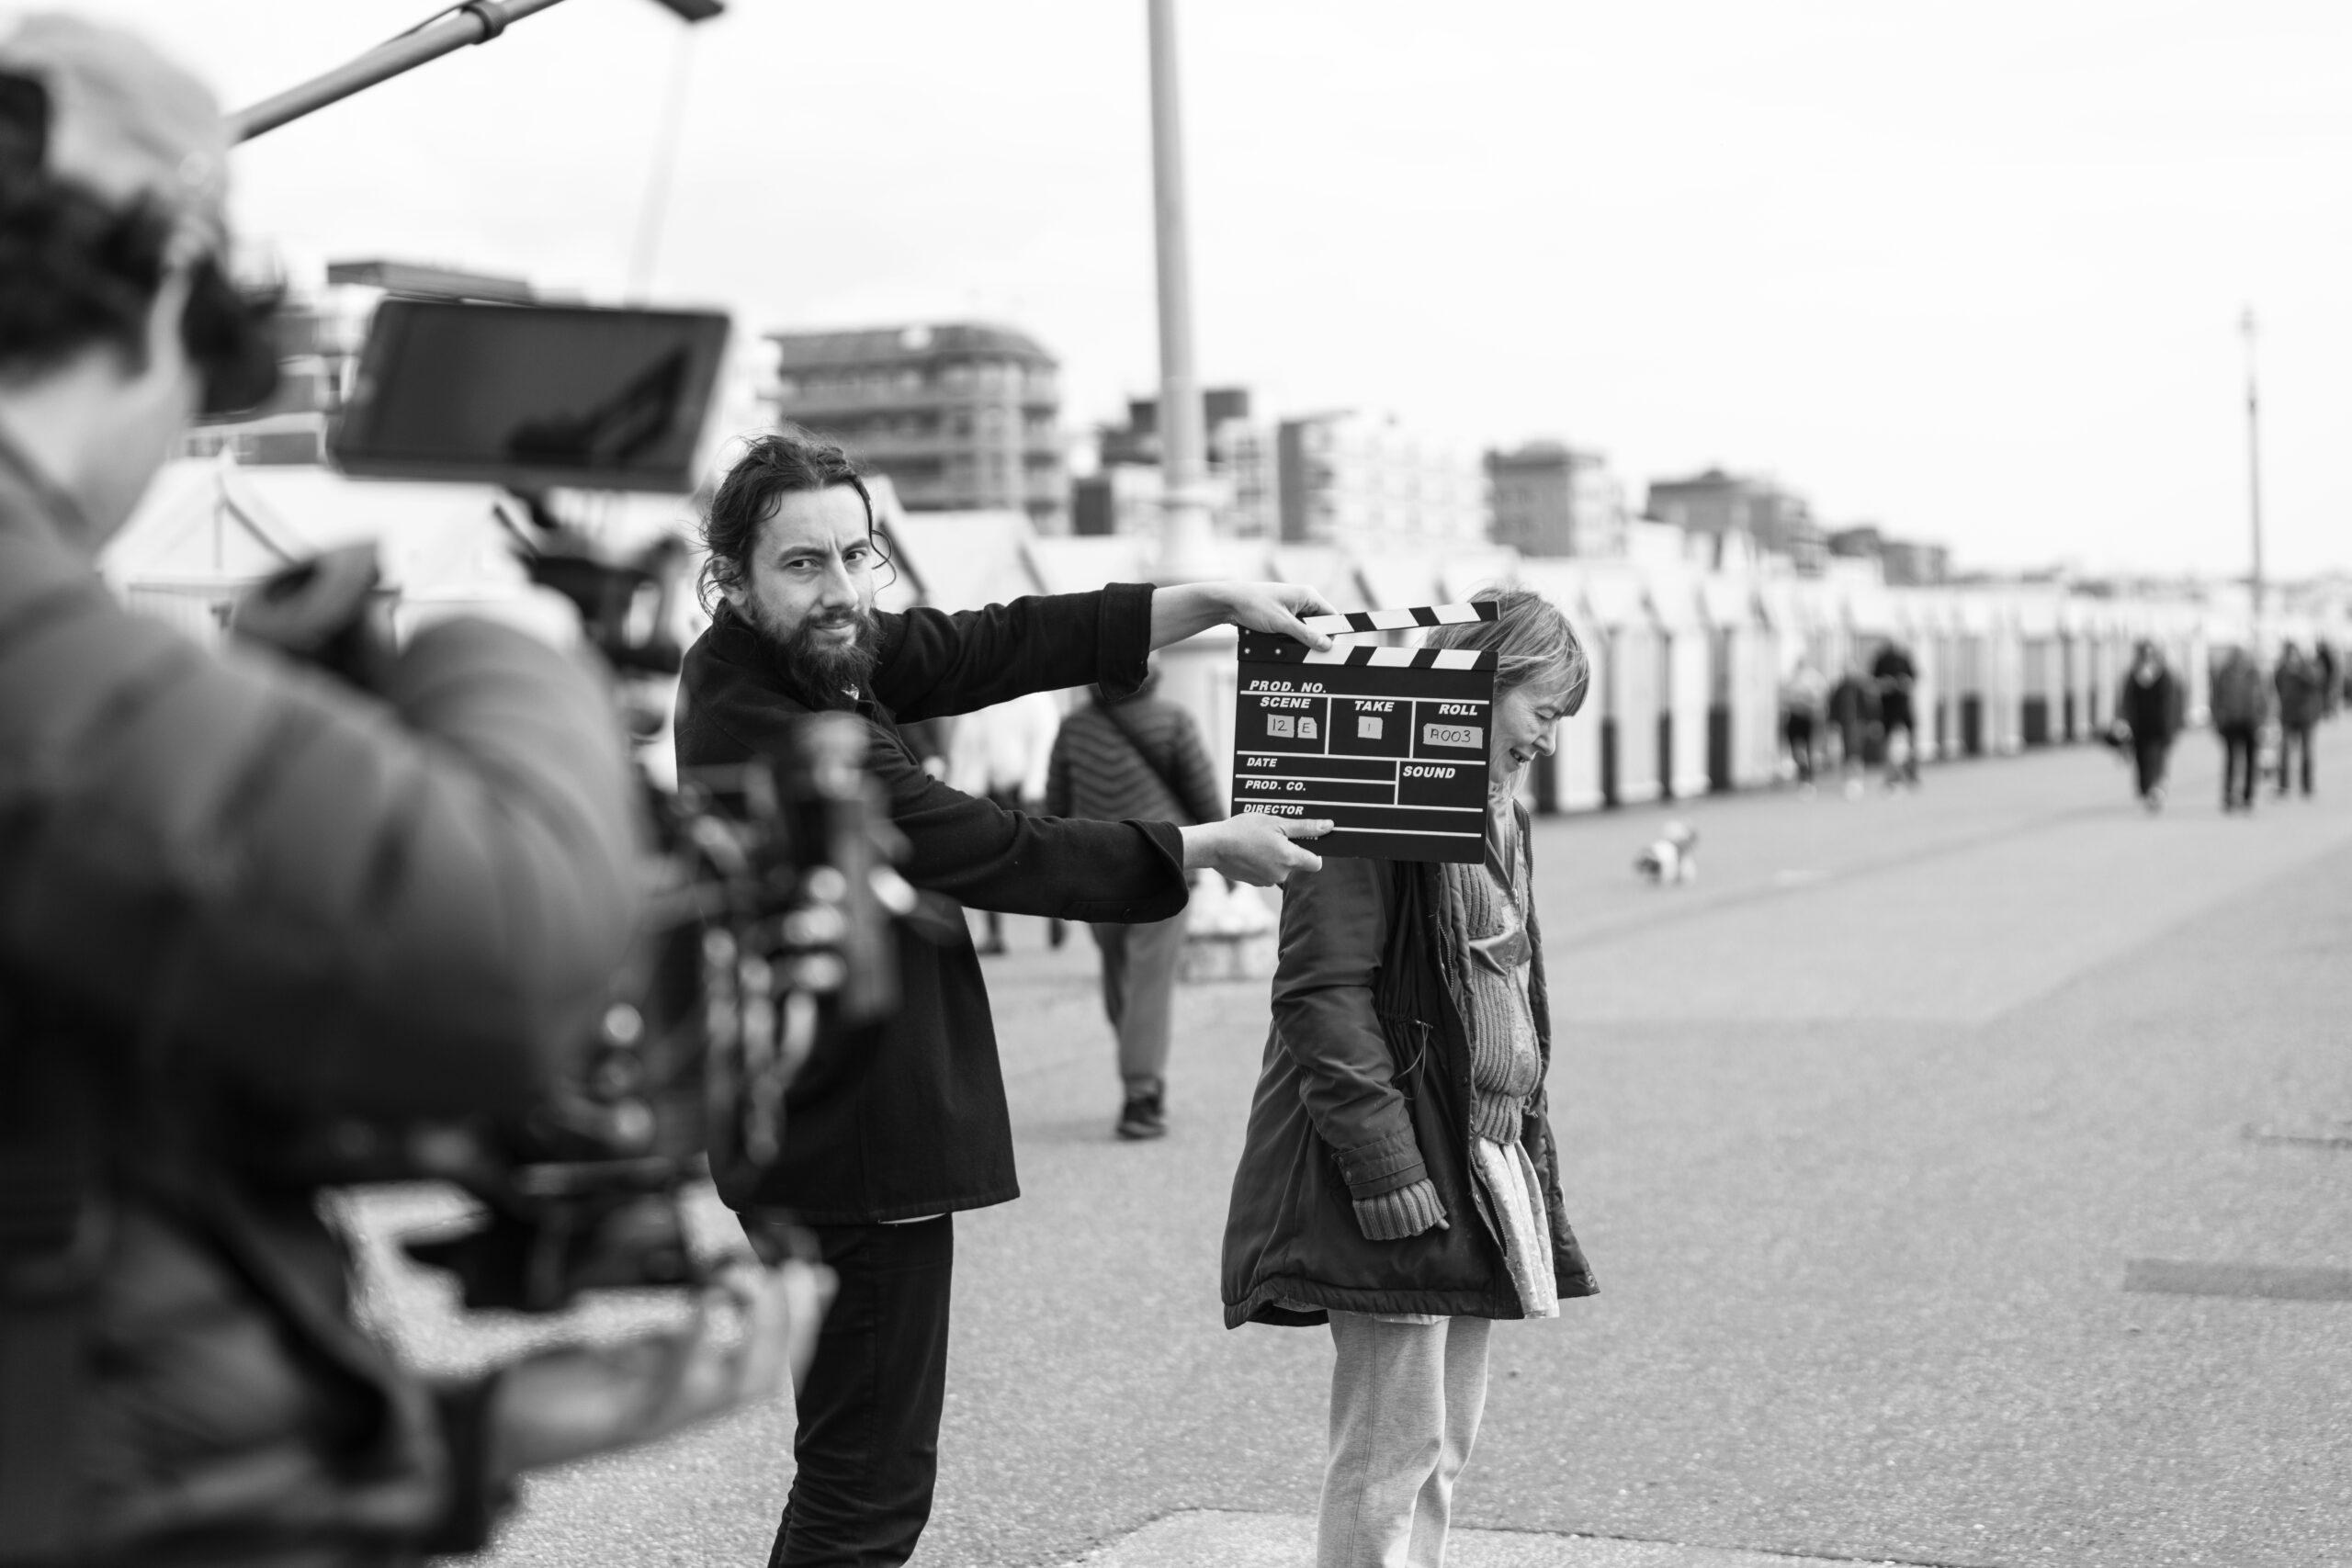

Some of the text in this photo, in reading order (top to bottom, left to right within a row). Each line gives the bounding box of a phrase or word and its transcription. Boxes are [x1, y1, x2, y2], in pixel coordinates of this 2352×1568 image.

[1250, 680, 1327, 694] PROD. NO.
[1260, 696, 1311, 708] SCENE
[1354, 701, 1395, 712] TAKE
[1438, 704, 1478, 716] ROLL
[1272, 717, 1311, 733] 12 E
[1430, 728, 1471, 743] A003
[1247, 757, 1278, 768] DATE
[1402, 765, 1456, 779] SOUND
[1245, 780, 1306, 791] PROD. CO.
[1243, 804, 1305, 815] DIRECTOR
